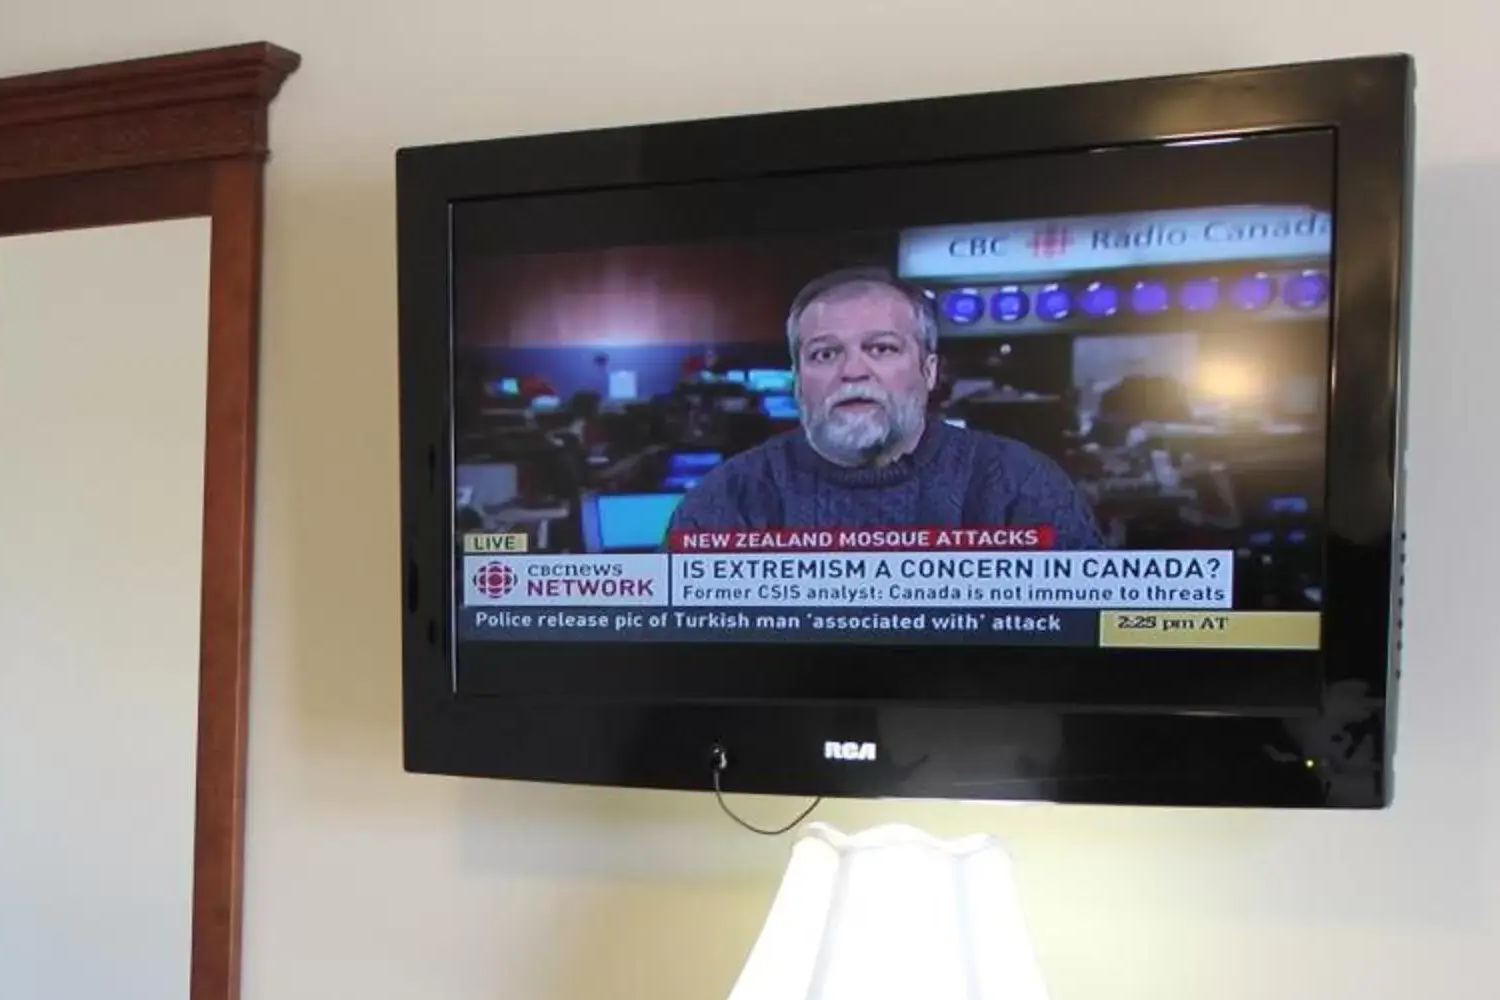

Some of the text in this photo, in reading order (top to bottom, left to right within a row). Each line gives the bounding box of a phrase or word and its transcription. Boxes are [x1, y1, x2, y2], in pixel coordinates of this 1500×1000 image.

[948, 235, 1008, 258] CBC
[1091, 219, 1188, 251] Radio
[474, 535, 516, 550] LIVE
[683, 529, 1039, 548] NEW ZEALAND MOSQUE ATTACKS
[683, 557, 1221, 579] IS EXTREMISM A CONCERN IN CANADA?
[527, 579, 655, 597] NETWORK
[683, 584, 1226, 603] Former CSIS analyst: Canada is not immune to threats
[475, 611, 533, 628] Police
[538, 611, 609, 628] release
[615, 611, 644, 631] pic
[649, 611, 669, 628] of
[673, 611, 750, 629] Turkish
[756, 614, 800, 629] man
[991, 613, 1062, 631] attack
[1162, 617, 1195, 631] pm
[1200, 616, 1230, 630] AT
[824, 741, 877, 761] RCA
